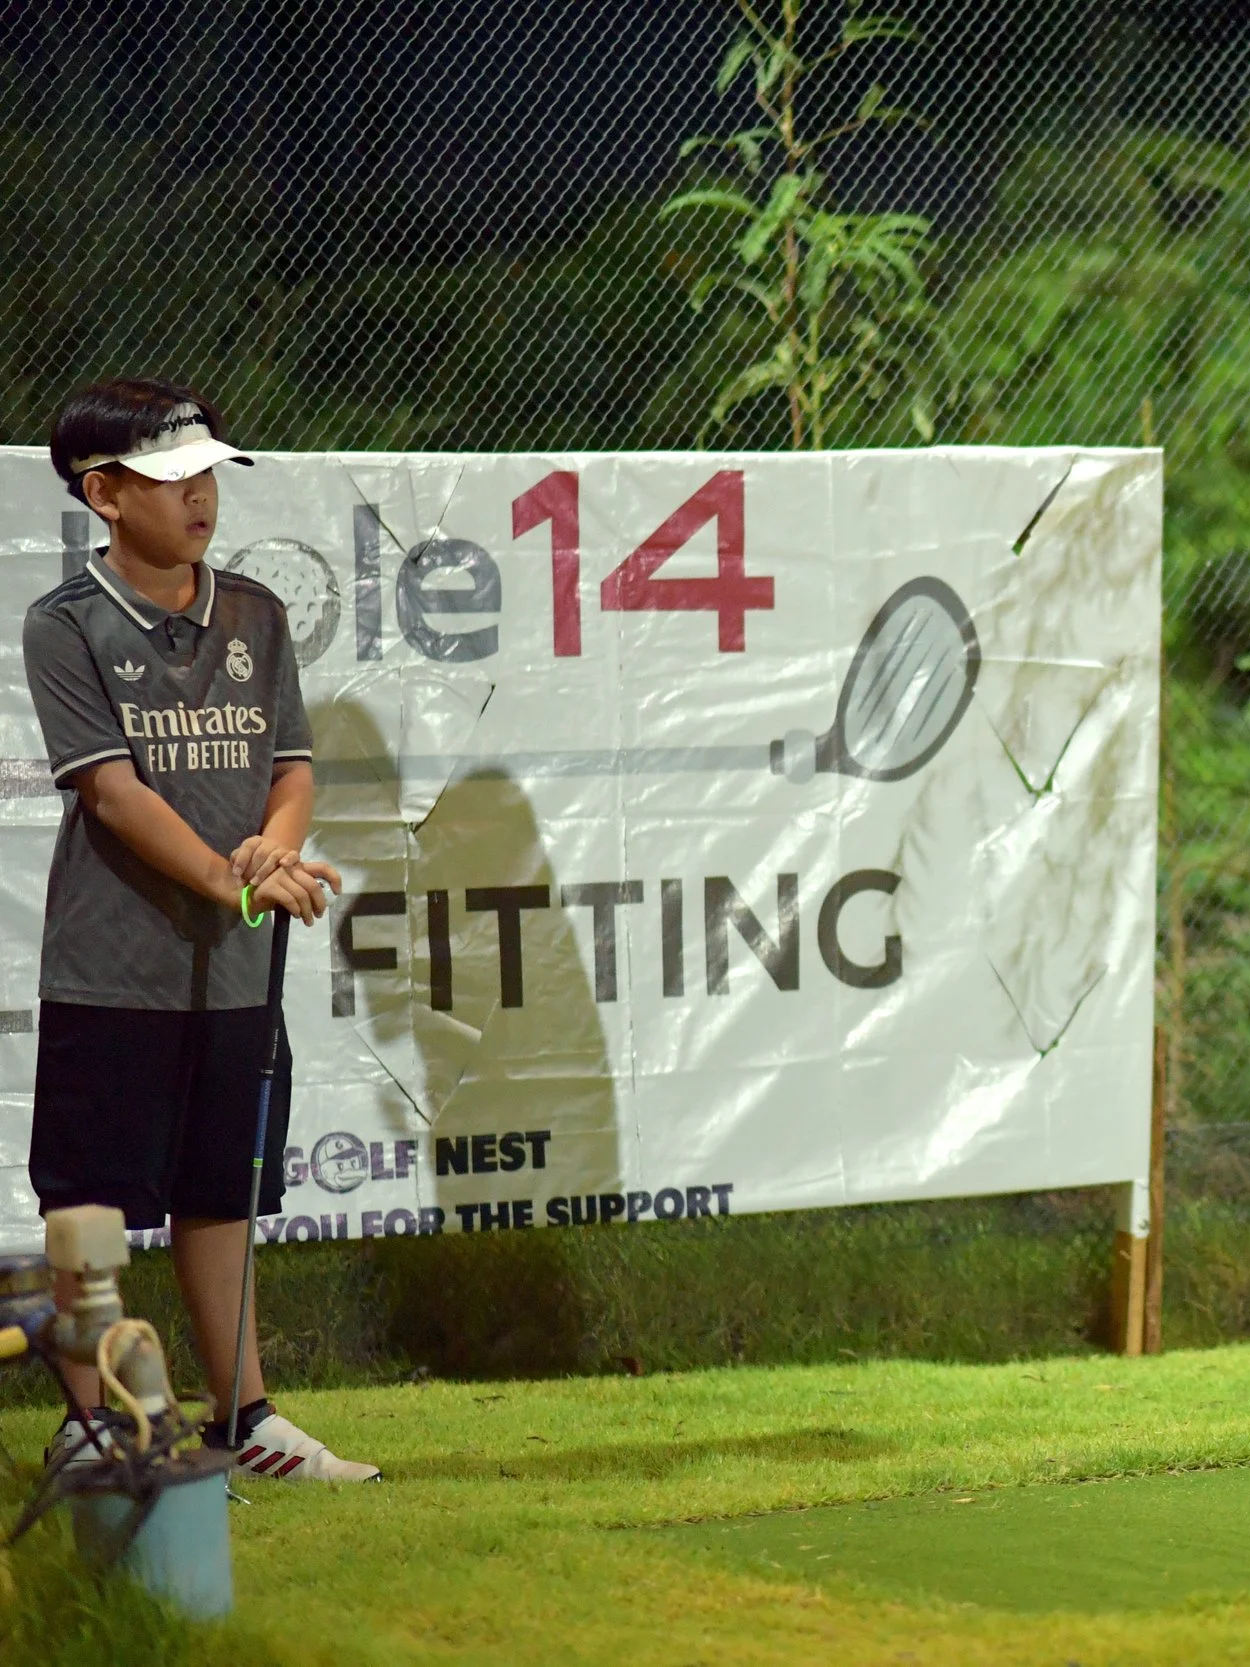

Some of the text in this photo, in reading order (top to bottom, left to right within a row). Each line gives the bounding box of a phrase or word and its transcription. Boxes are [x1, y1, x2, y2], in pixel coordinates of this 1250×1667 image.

[119, 701, 267, 738] Emirates
[148, 740, 250, 773] FLY BETTER
[329, 868, 904, 1018] FITTING
[284, 1129, 551, 1194] GOLF NEST
[256, 1183, 734, 1244] YOU FOR THE SUPPORT
